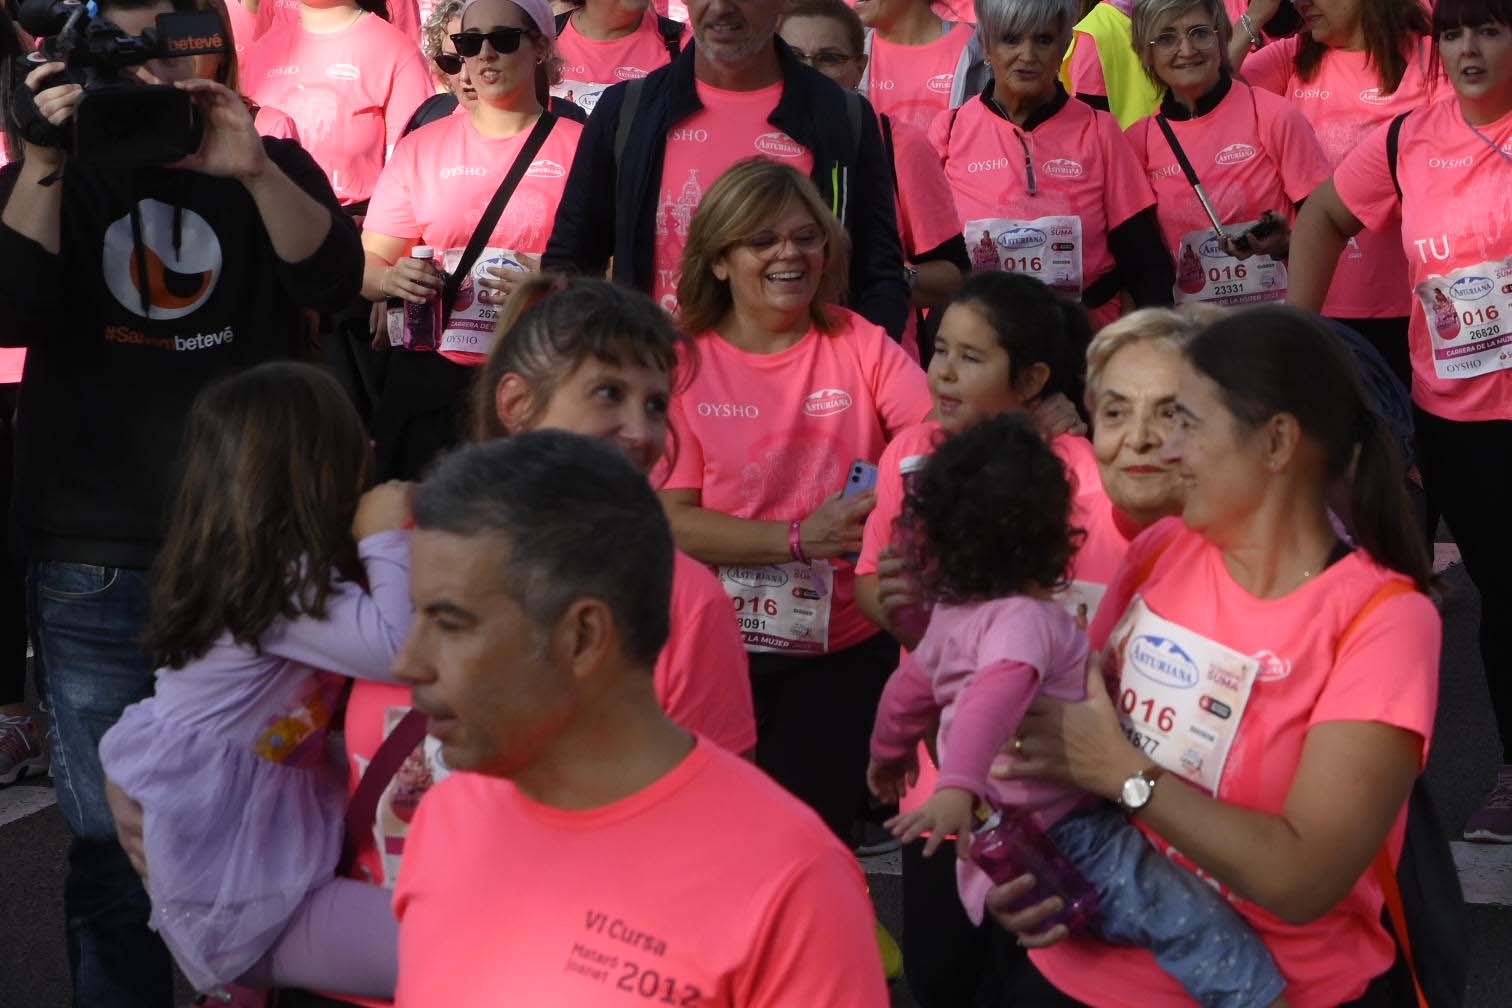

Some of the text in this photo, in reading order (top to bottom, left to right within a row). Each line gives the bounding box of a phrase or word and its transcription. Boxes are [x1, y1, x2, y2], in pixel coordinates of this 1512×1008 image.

[967, 157, 1008, 174] OYSHO
[1429, 156, 1474, 169] OYSHO
[998, 233, 1045, 246] ASTURIANA
[1050, 228, 1073, 237] SUMA
[1413, 234, 1450, 264] TU
[1003, 255, 1042, 272] 016
[1207, 263, 1248, 282] 016
[1214, 283, 1245, 295] 23331
[1454, 283, 1492, 297] ASTURIANA
[1462, 305, 1499, 326] 016
[450, 320, 490, 331] CARRERA DE
[1469, 324, 1500, 340] 26820
[447, 335, 478, 346] OYSHO
[1446, 345, 1477, 357] CARRERA
[1476, 342, 1486, 350] DE
[1486, 340, 1496, 349] LA
[1446, 359, 1482, 373] OYSHO
[697, 402, 759, 419] OYSHO
[805, 398, 850, 412] ASTURIANA
[748, 635, 790, 648] LA MUJER
[1132, 645, 1193, 684] ASTURIANA
[1120, 687, 1177, 732] 016
[585, 909, 668, 958] VI Cursa
[616, 961, 703, 1008] 2012
